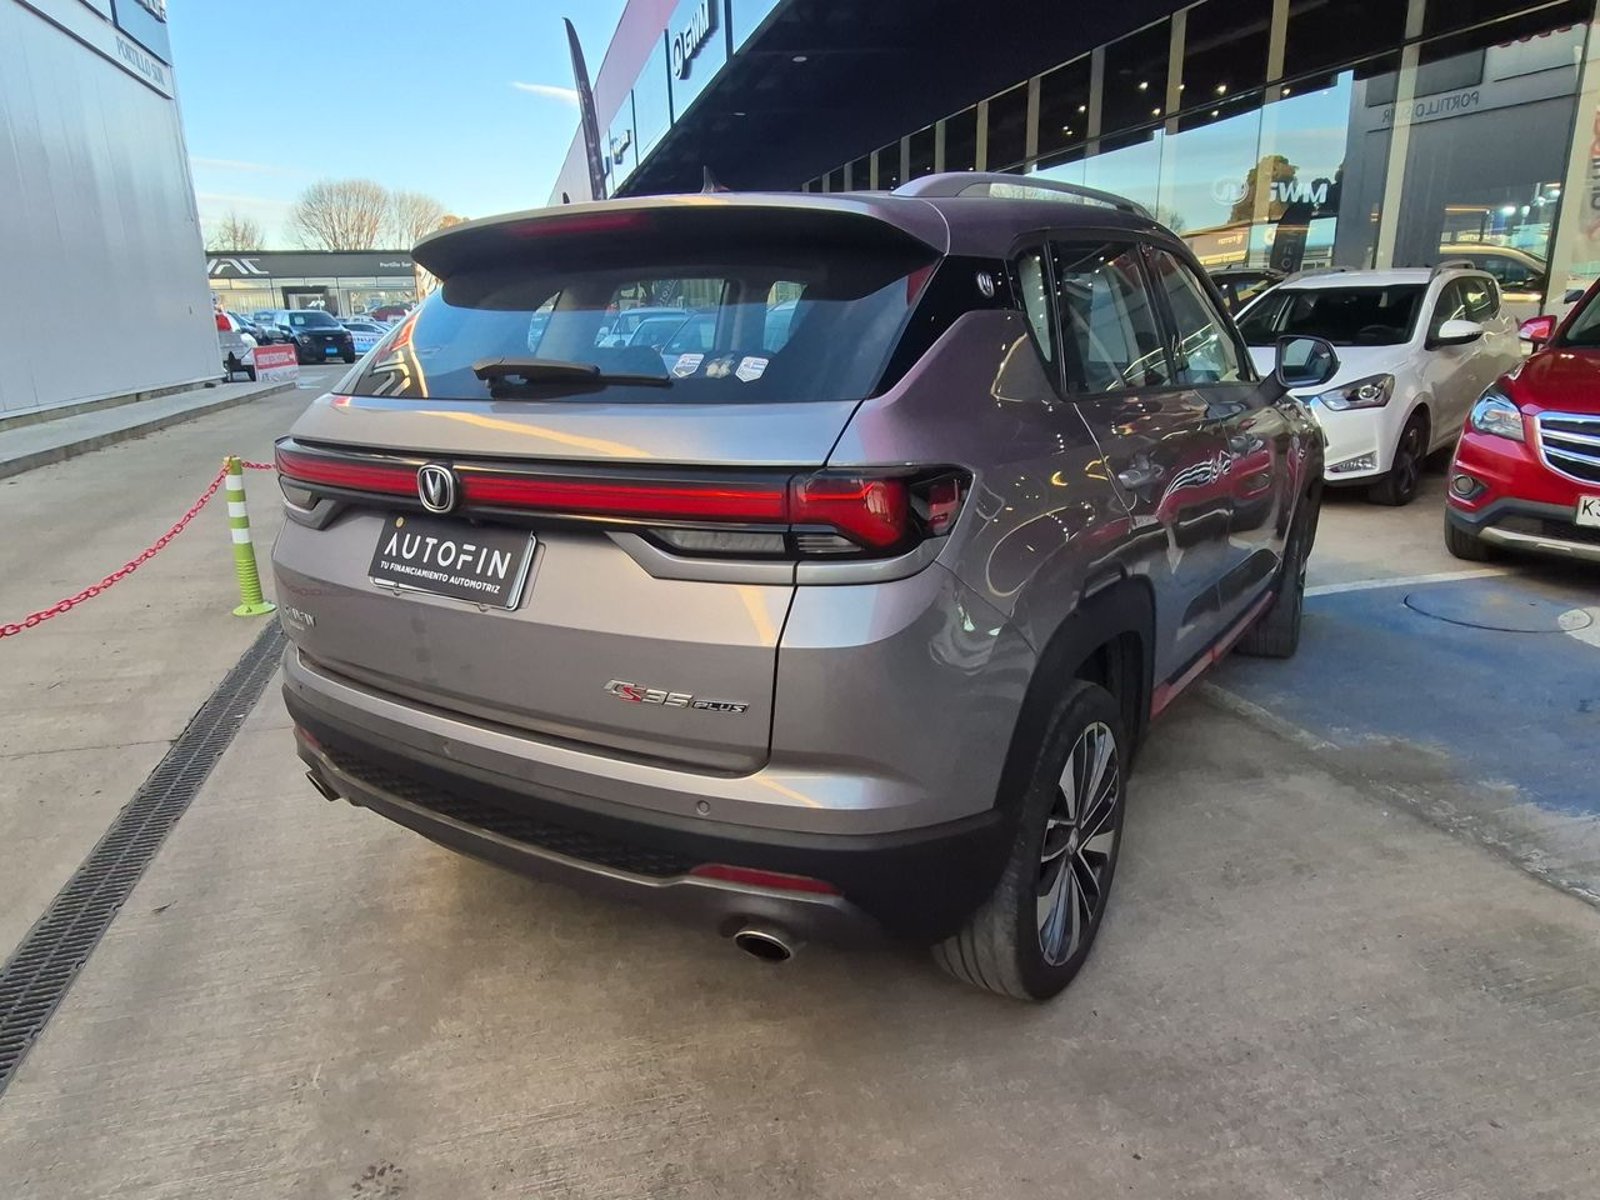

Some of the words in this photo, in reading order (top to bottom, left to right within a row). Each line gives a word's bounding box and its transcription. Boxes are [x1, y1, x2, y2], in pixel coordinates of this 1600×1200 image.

[685, 0, 710, 60] GWM
[116, 35, 152, 78] PORTILLO
[380, 560, 389, 570] TU
[389, 562, 449, 583] FINANCIAMIENTO
[449, 575, 501, 594] AUTOMOTRIZ
[384, 532, 512, 579] AUTOFIN
[694, 701, 748, 714] PLUS
